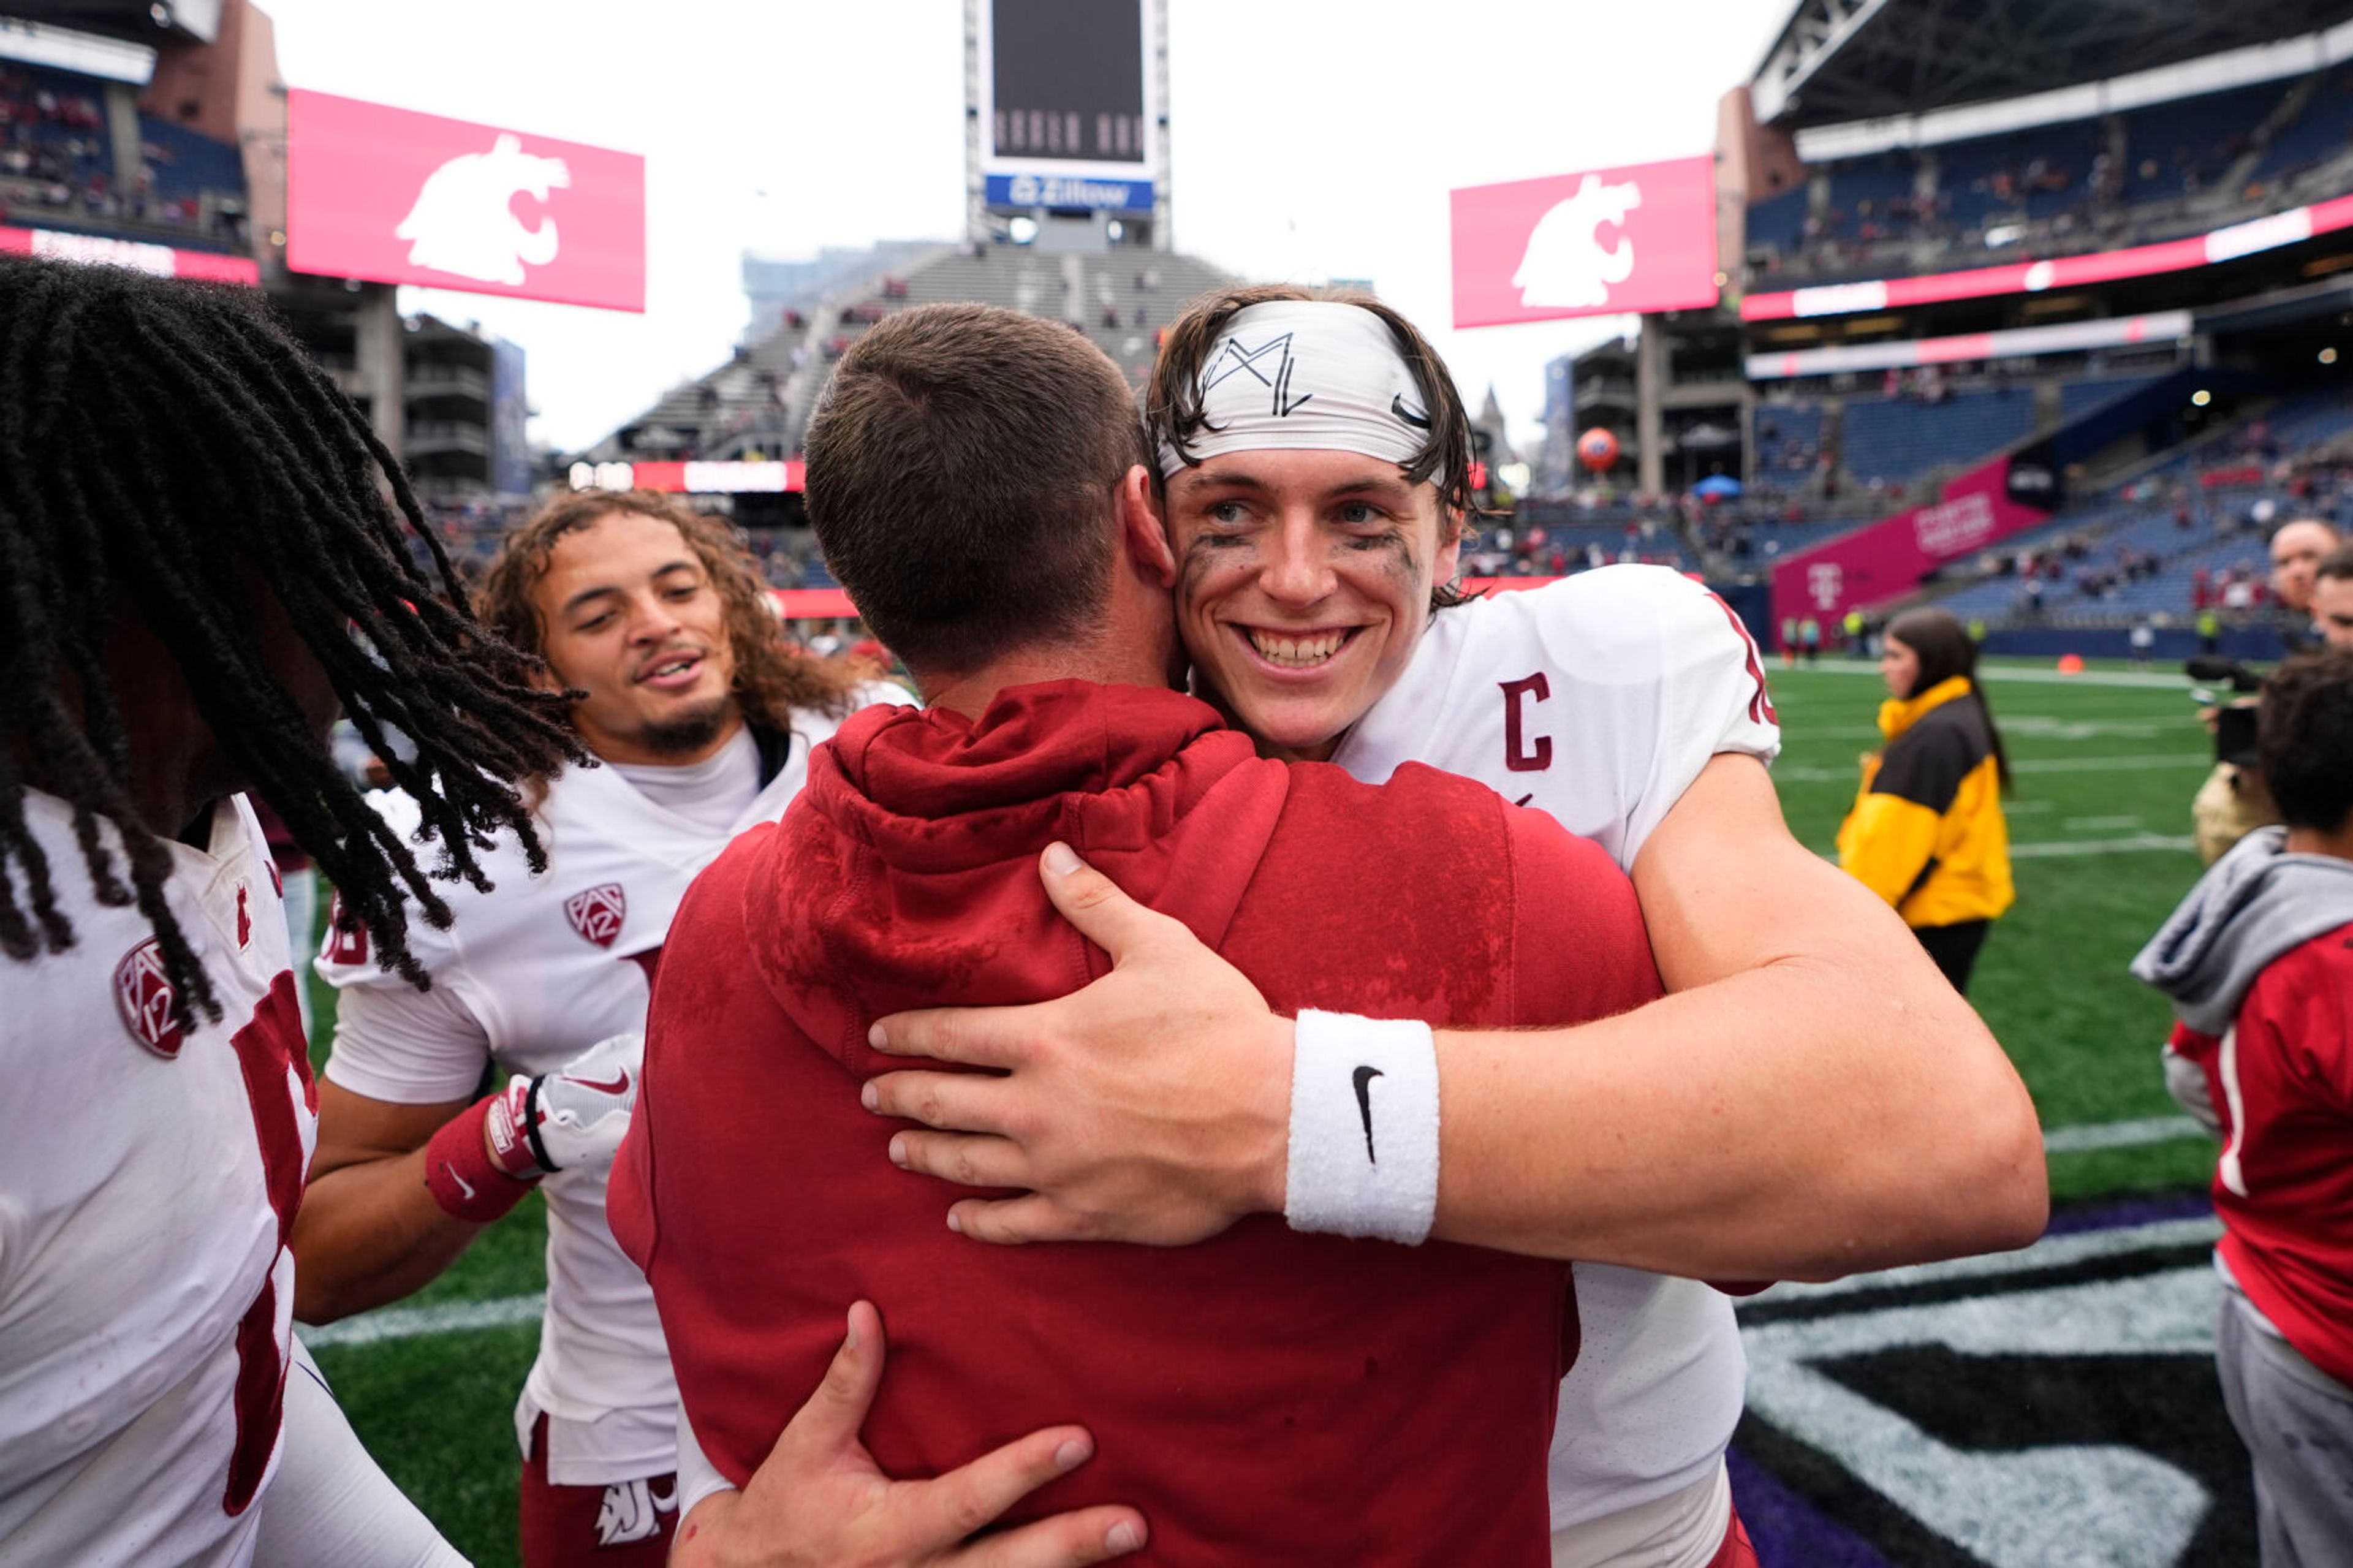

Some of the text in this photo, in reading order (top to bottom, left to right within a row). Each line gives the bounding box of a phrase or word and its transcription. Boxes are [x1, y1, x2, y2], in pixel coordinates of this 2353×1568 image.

[1040, 178, 1131, 207] Zillow
[1497, 672, 1552, 772] C
[567, 884, 623, 931] PAC
[586, 911, 617, 940] 12
[143, 986, 178, 1044] 12
